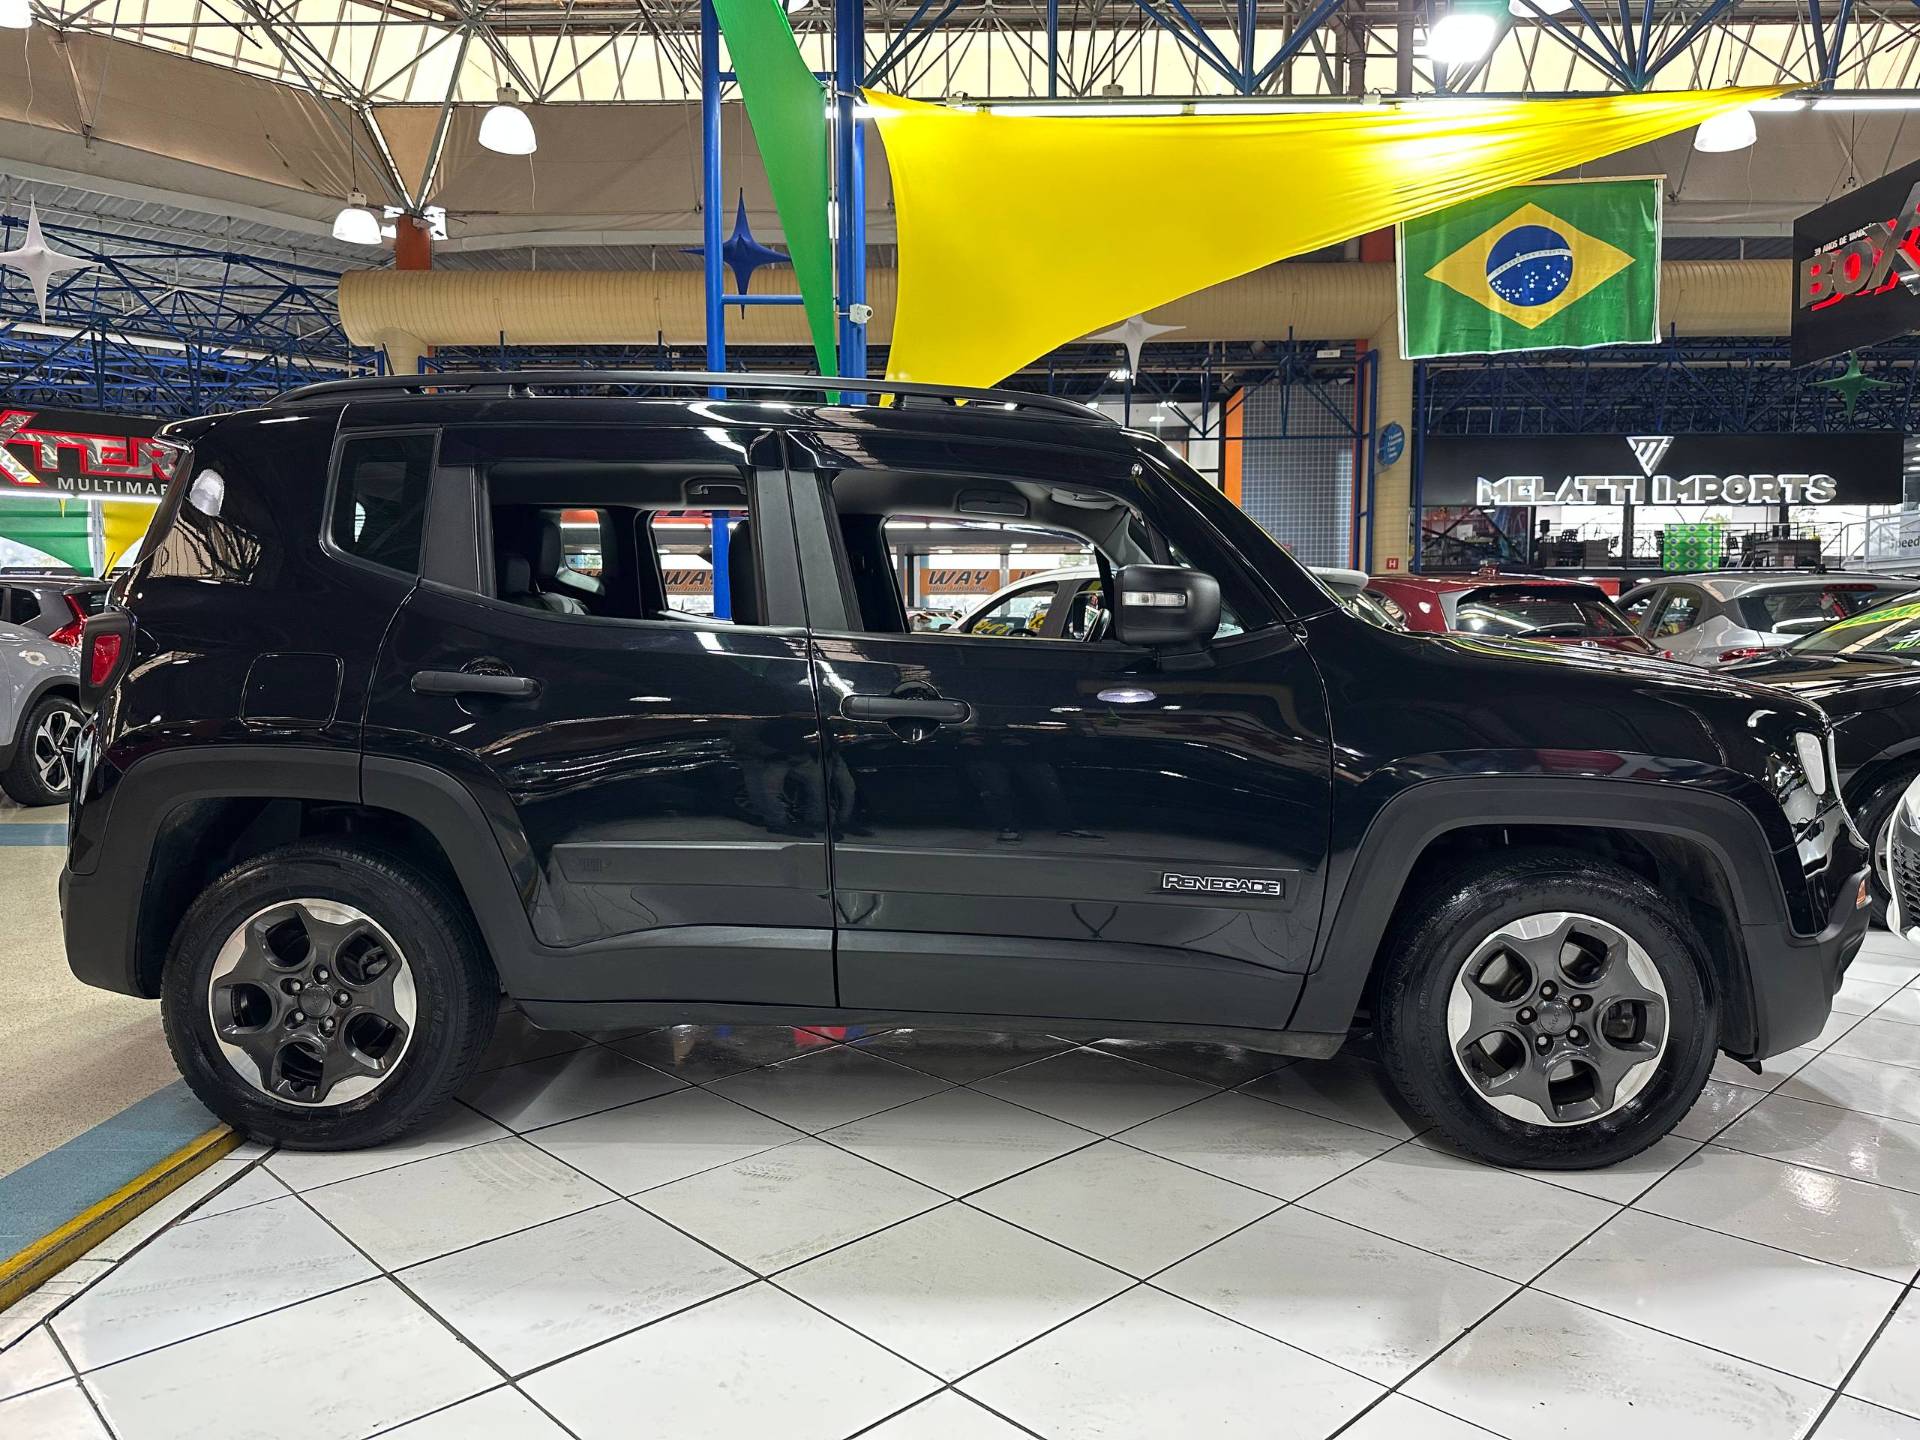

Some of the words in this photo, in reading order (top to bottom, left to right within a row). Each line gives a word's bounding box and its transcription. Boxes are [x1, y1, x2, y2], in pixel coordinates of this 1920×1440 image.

[1823, 240, 1837, 253] ANOS
[1839, 235, 1847, 245] DE
[1476, 476, 1644, 505] MELATTI
[1652, 474, 1837, 504] IMPORTS
[664, 571, 713, 585] WA
[927, 570, 989, 585] WAY
[1163, 873, 1280, 896] RENEGADE
